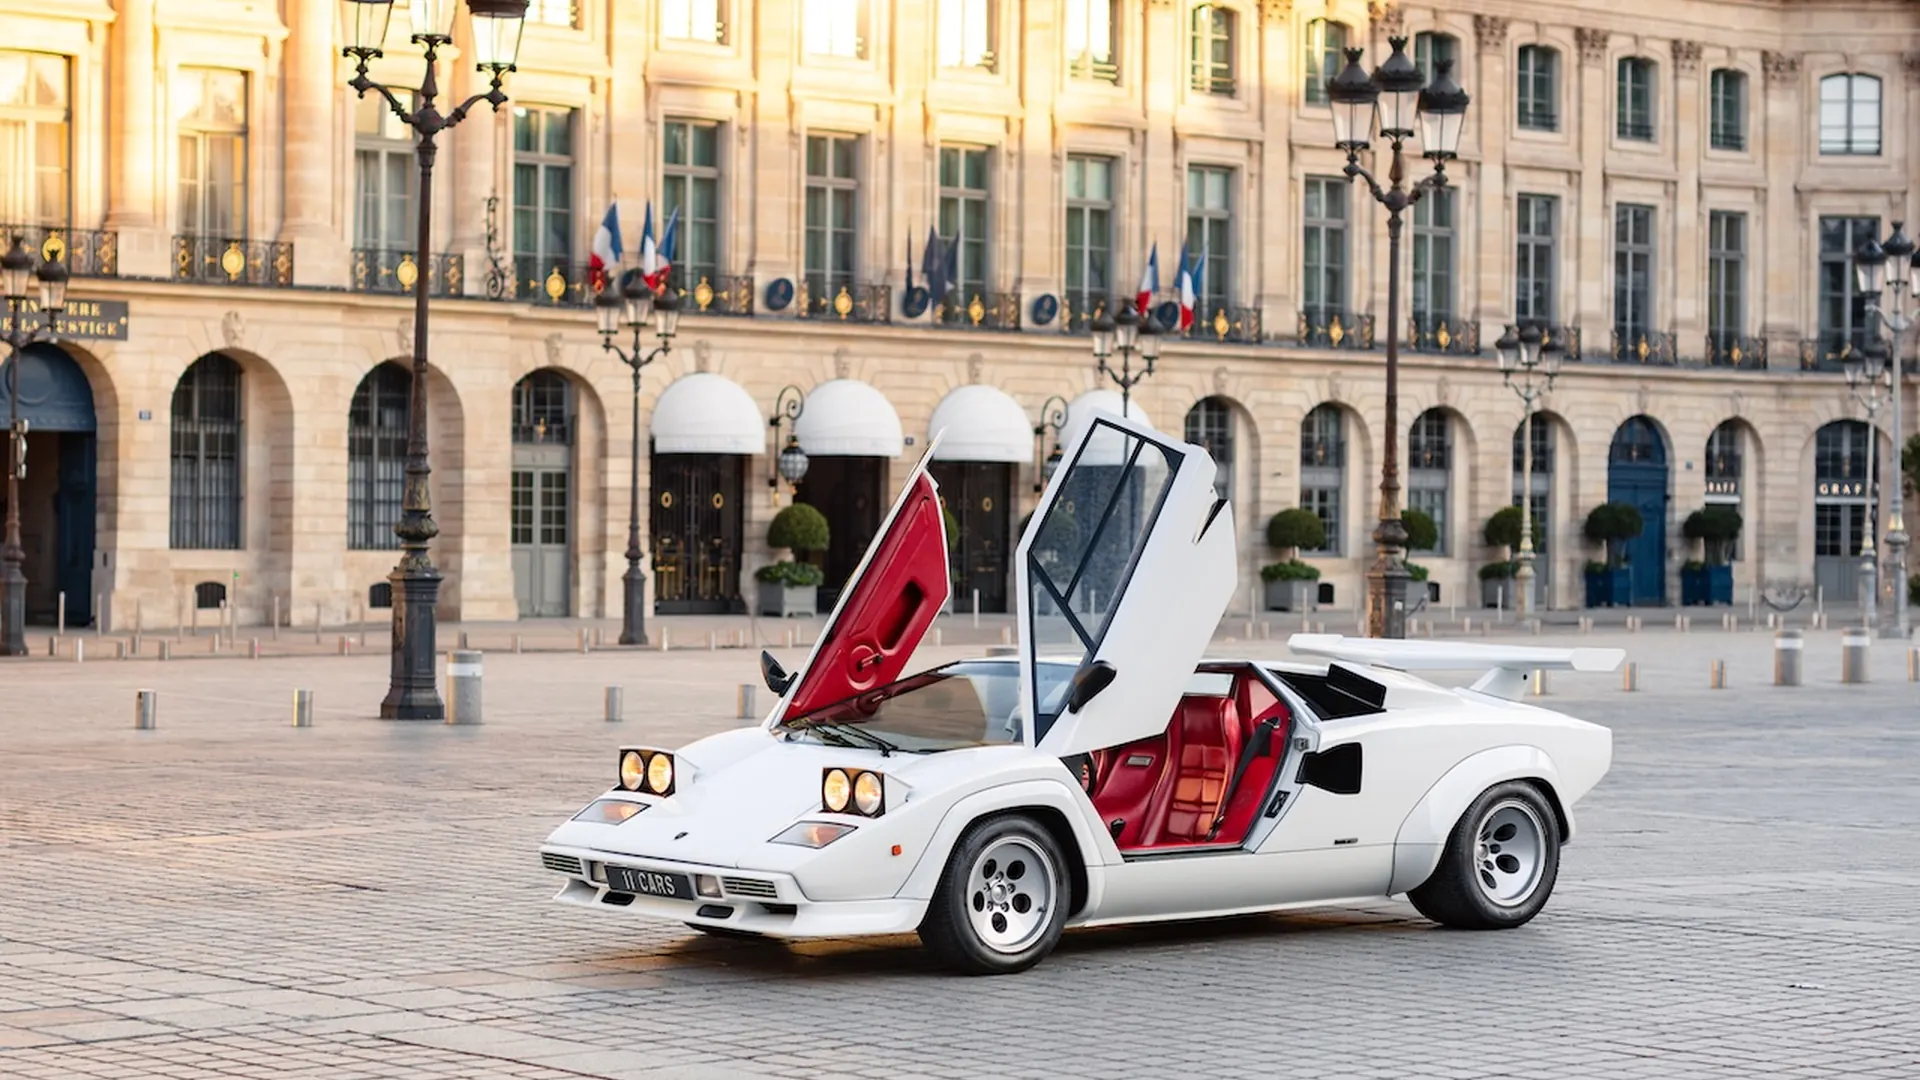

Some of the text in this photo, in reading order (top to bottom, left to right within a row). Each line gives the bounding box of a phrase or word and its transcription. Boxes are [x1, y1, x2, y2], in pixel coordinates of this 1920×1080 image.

[46, 320, 117, 336] USTICE
[1819, 482, 1872, 496] GRAF
[622, 870, 676, 895] 11 CARS
